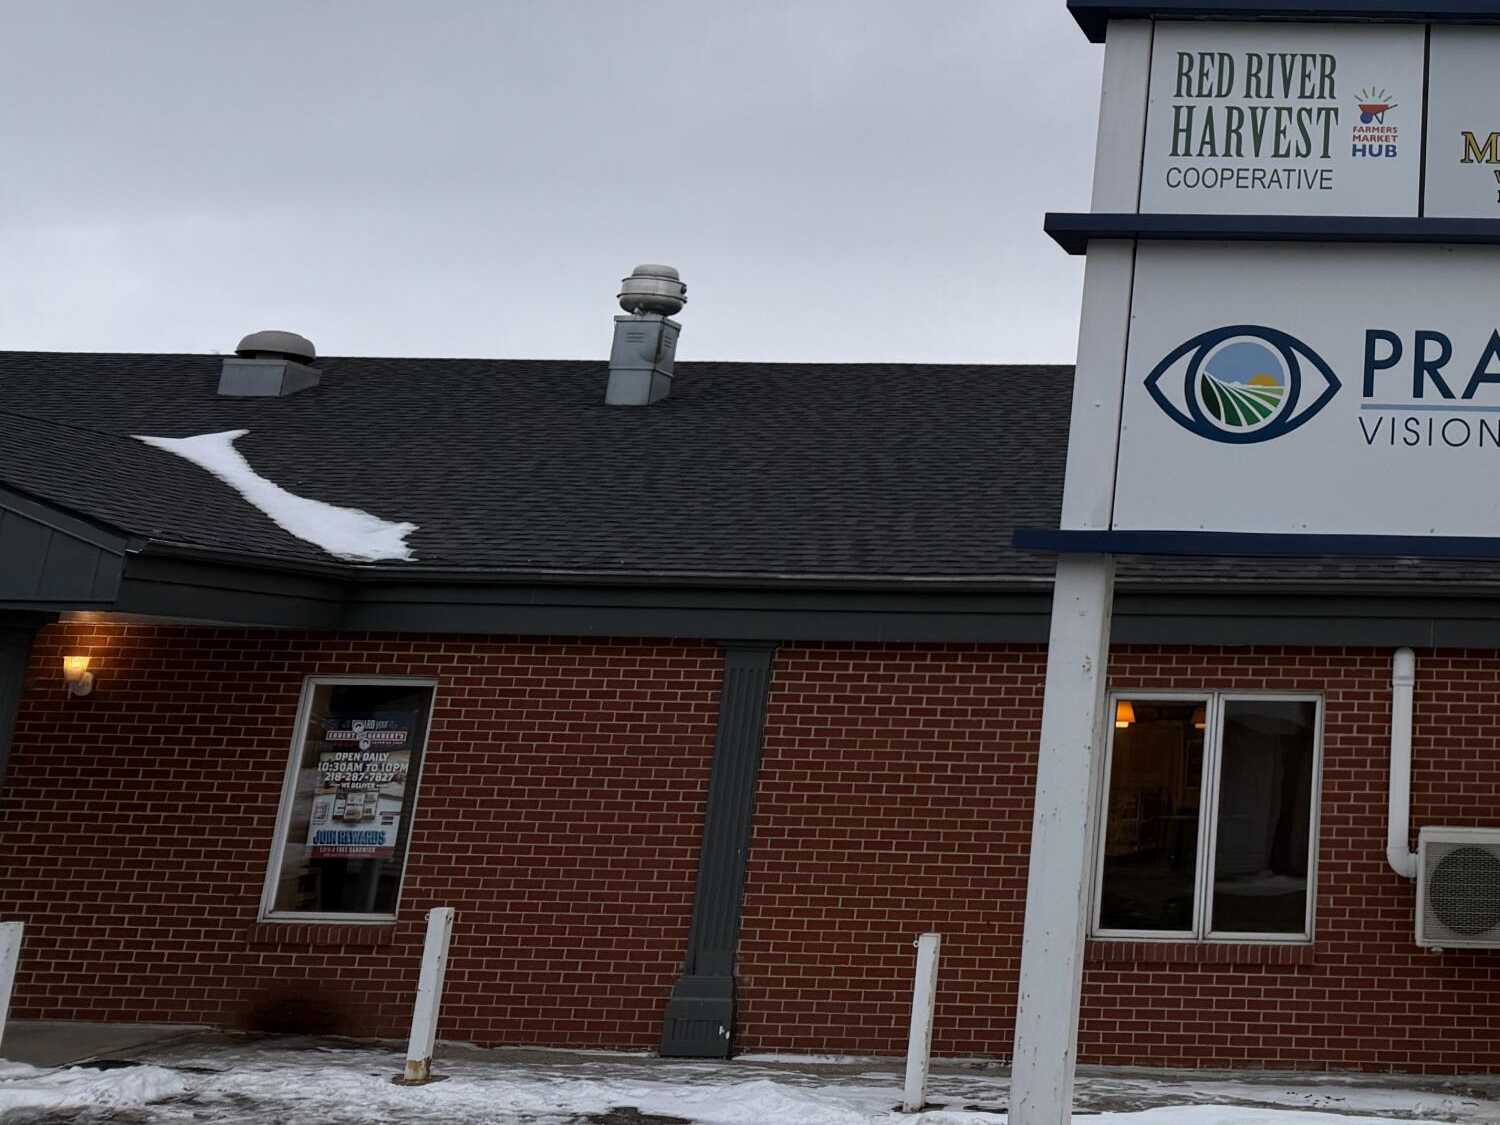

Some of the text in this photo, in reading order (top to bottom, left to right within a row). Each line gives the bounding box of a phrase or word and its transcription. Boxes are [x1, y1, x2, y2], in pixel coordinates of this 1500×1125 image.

[1174, 51, 1337, 100] RED RIVER
[1168, 105, 1339, 159] HARVEST
[1352, 126, 1398, 134] FARMERS
[1352, 135, 1398, 143] MARKET
[1352, 144, 1398, 157] HUB
[1166, 166, 1333, 190] COOPERATIVE
[335, 752, 389, 762] OPEN DAILY
[317, 762, 362, 772] 10:30AM
[381, 763, 409, 773] 10PM
[324, 772, 394, 782] 218-287-7827
[313, 830, 386, 845] JOIN REWARDS
